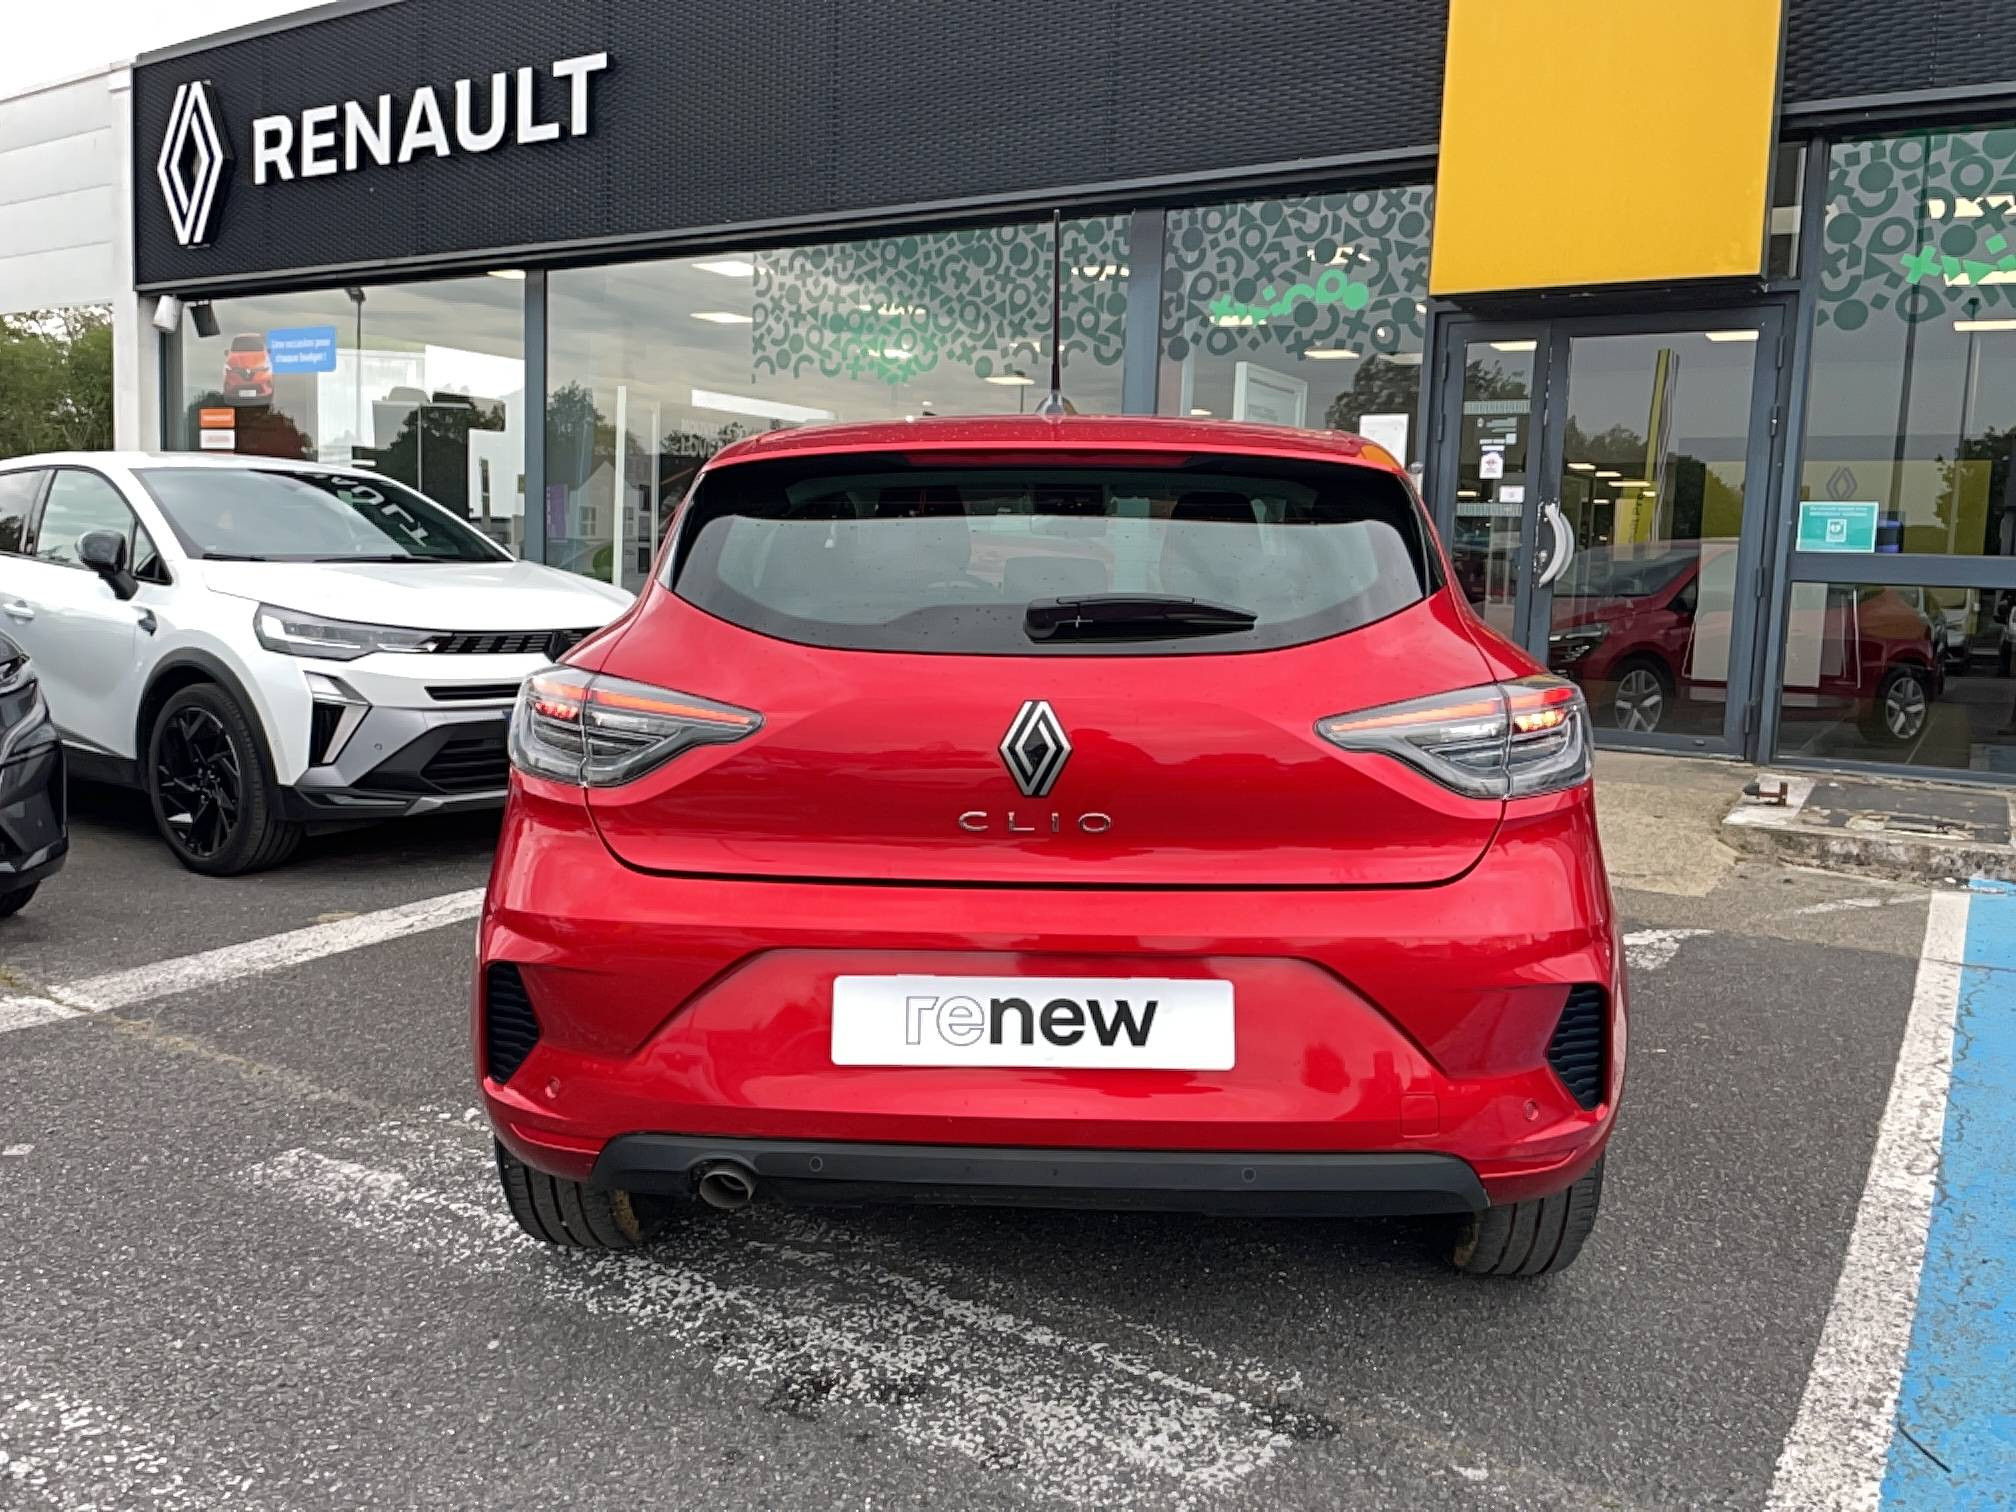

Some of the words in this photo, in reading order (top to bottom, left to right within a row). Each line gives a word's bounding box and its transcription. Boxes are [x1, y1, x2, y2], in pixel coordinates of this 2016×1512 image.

[252, 51, 608, 185] RENAULT
[958, 811, 1112, 833] CLIO
[905, 995, 1158, 1047] renew
